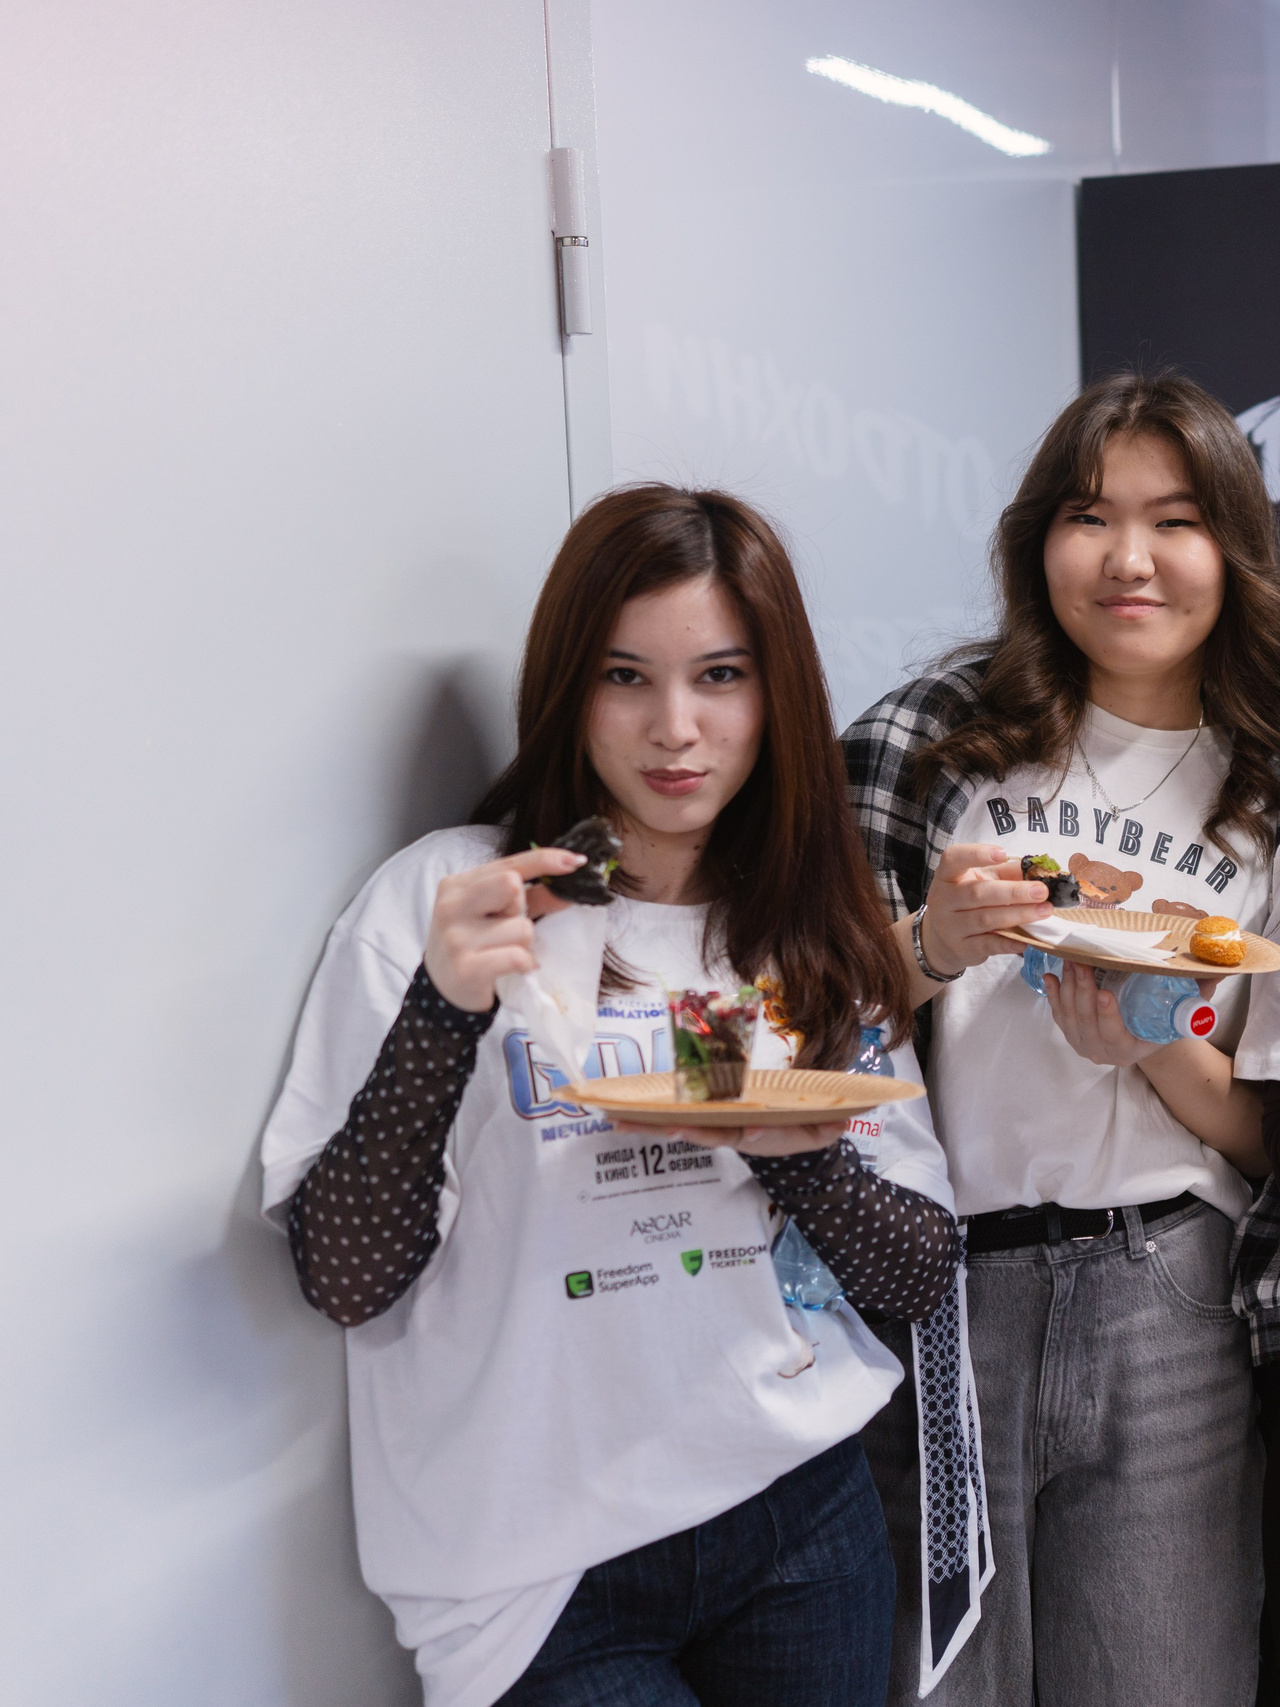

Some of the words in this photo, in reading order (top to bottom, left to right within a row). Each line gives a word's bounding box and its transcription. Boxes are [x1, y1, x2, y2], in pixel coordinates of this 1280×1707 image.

[986, 797, 1238, 895] BABYBEAR
[639, 1144, 665, 1176] 12
[668, 1154, 713, 1172] ФЕВРАЛЯ
[709, 1244, 768, 1260] FREEDOM
[597, 1263, 653, 1279] Freedom
[599, 1274, 660, 1293] SuperApp
